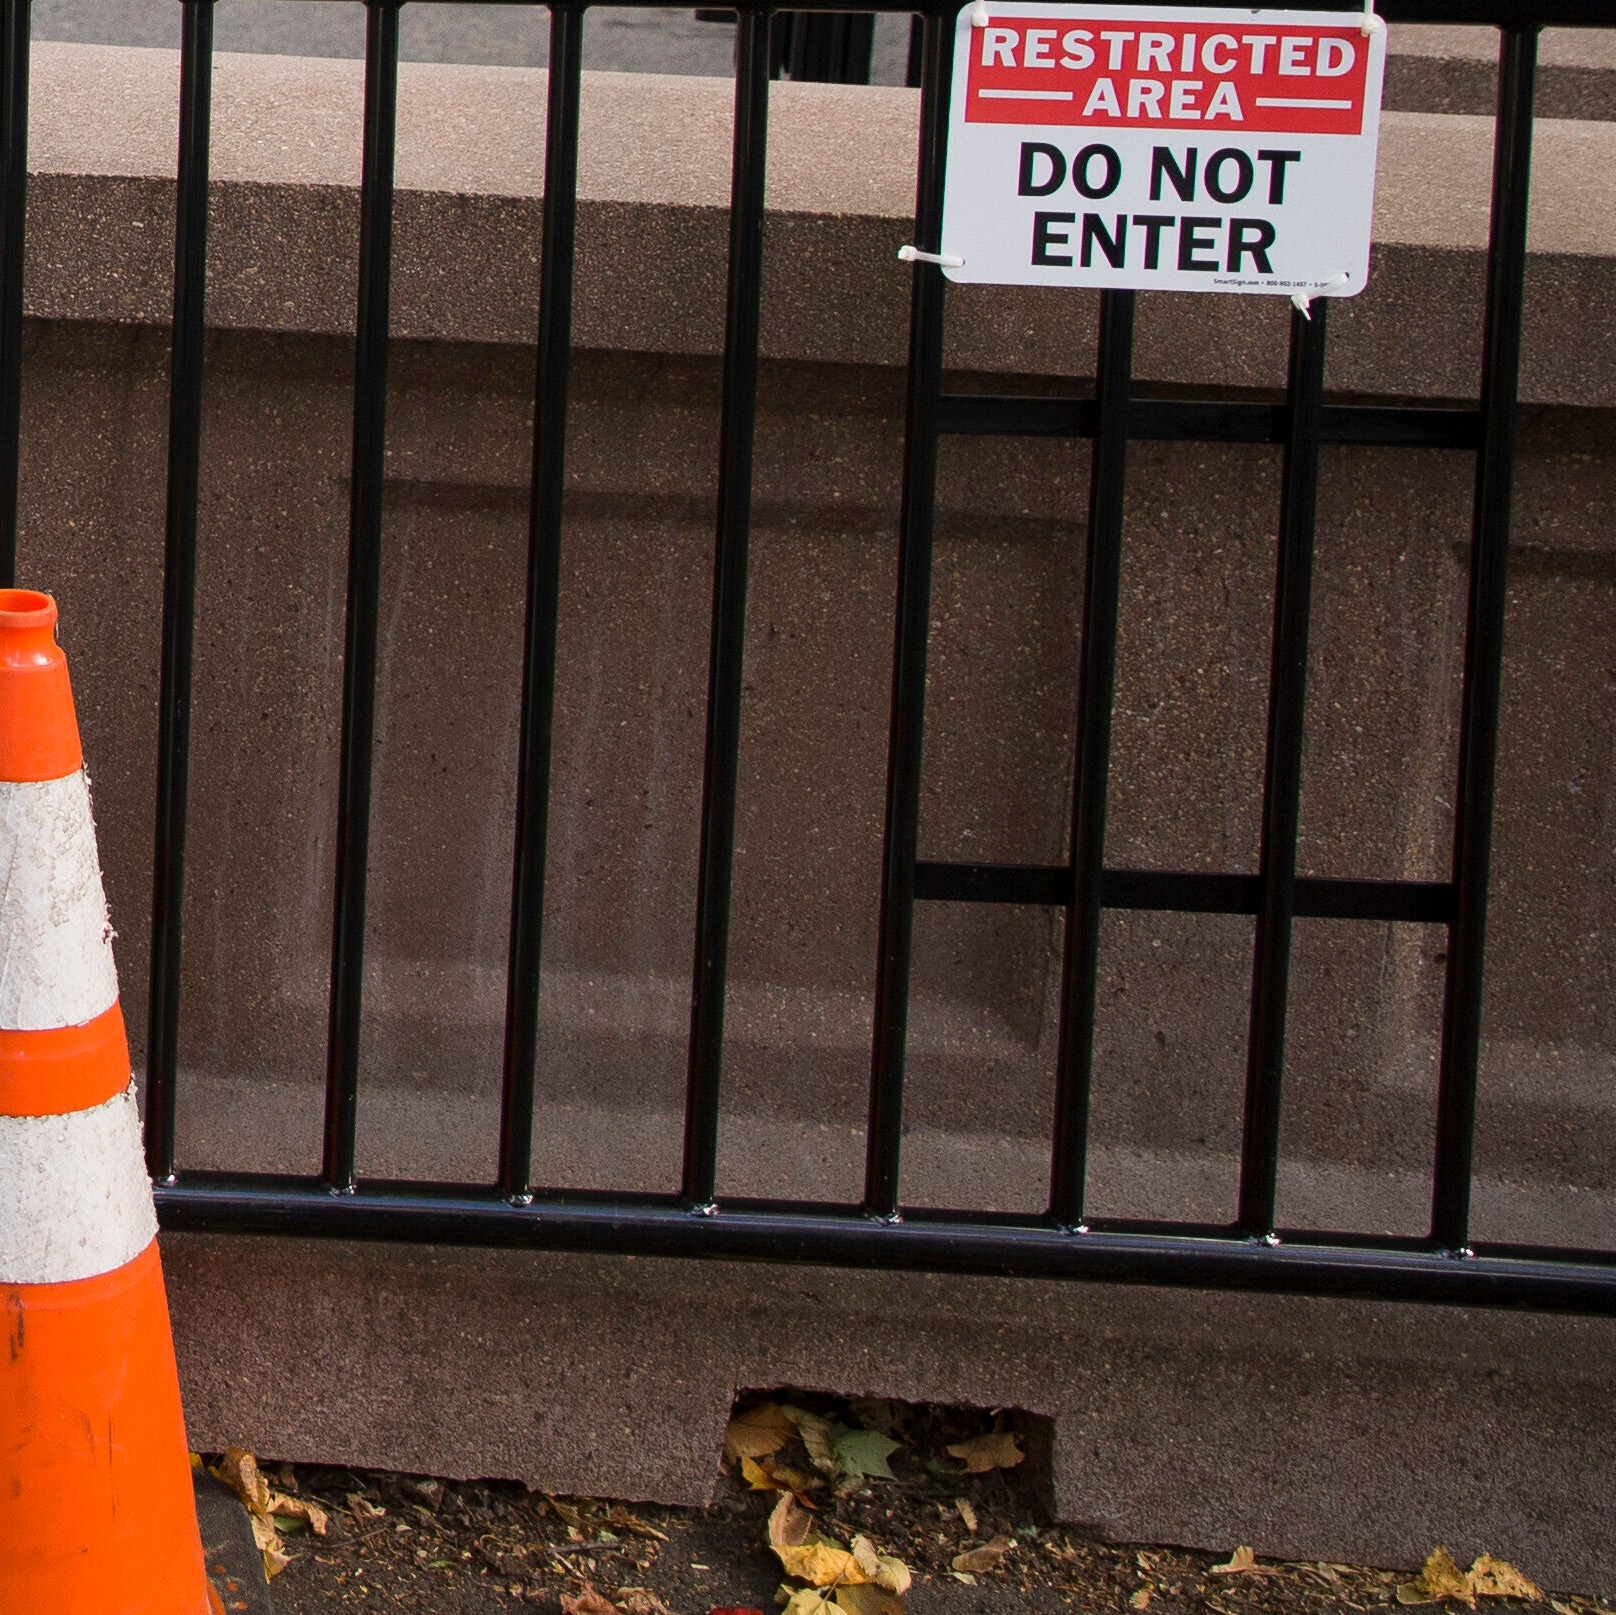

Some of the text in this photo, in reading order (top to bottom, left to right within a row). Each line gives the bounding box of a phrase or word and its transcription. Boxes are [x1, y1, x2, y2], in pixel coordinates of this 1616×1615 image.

[981, 27, 1357, 78] RESTRICTED
[1081, 77, 1245, 122] AREA
[1017, 141, 1302, 206] DO NOT
[1030, 210, 1277, 275] ENTER
